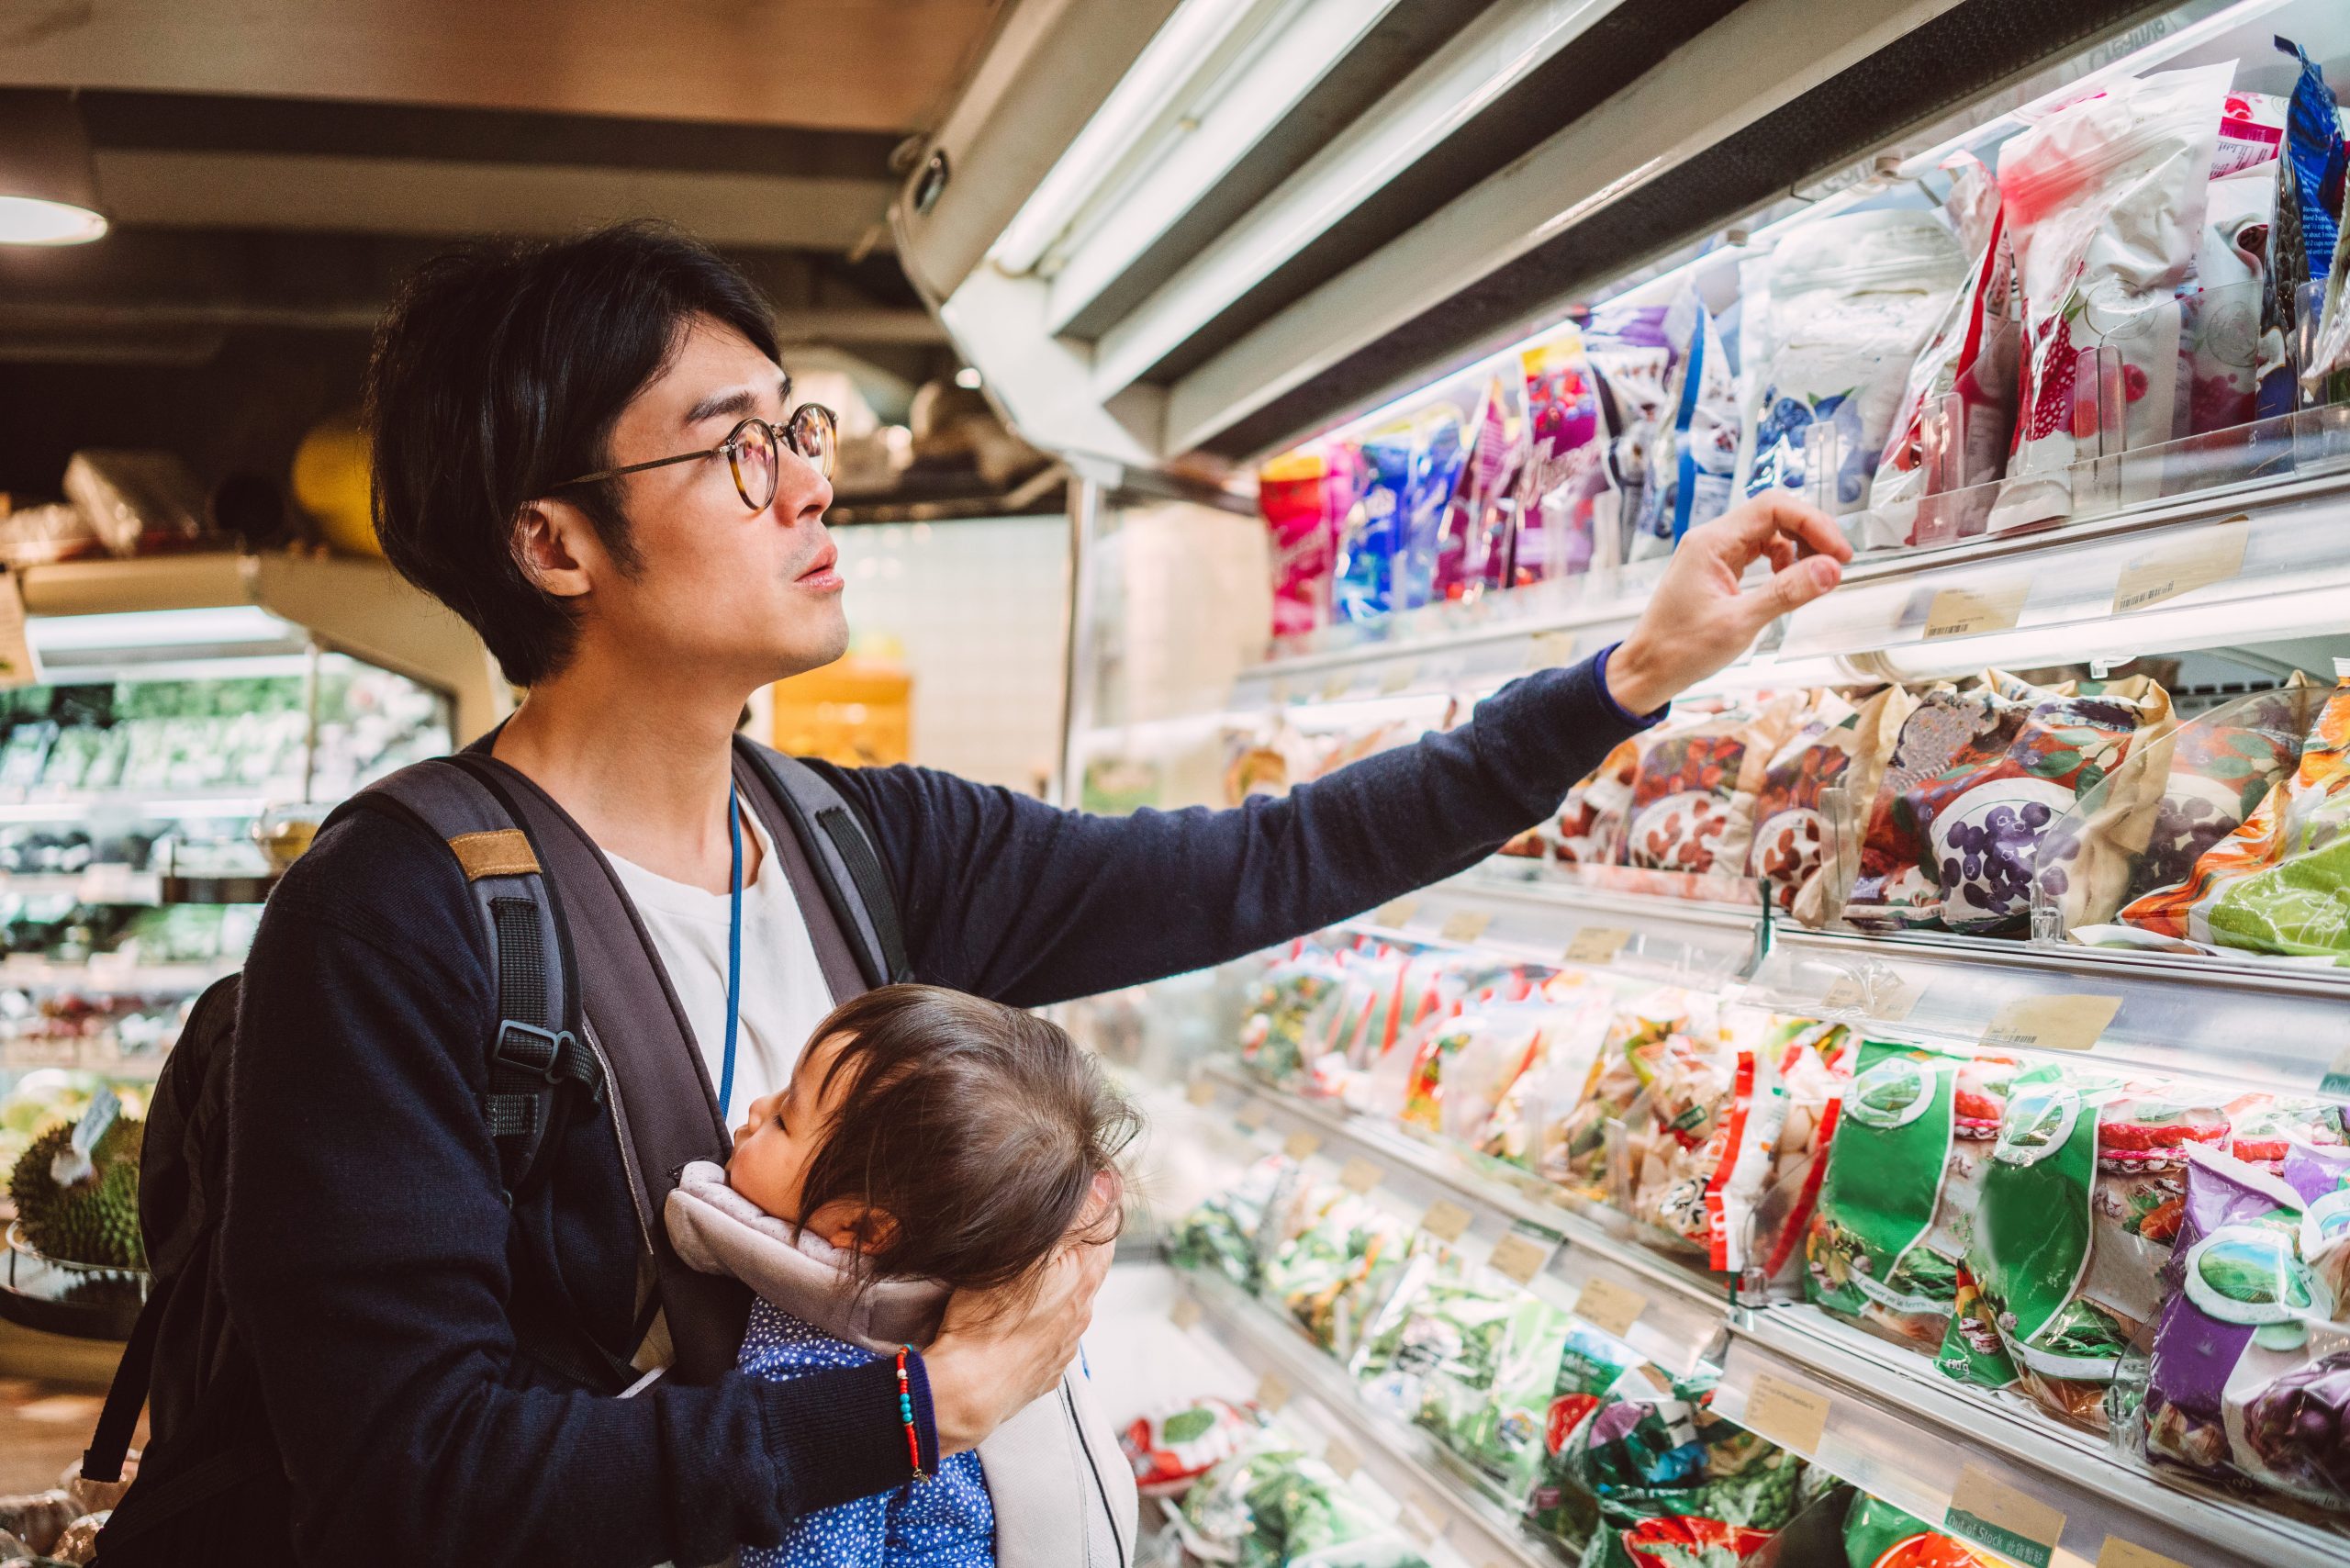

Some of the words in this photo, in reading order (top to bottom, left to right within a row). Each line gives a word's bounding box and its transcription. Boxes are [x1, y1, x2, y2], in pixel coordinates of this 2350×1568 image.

[1947, 1514, 1964, 1532] Out
[1965, 1523, 1977, 1536] of
[1978, 1527, 2004, 1548] Stock
